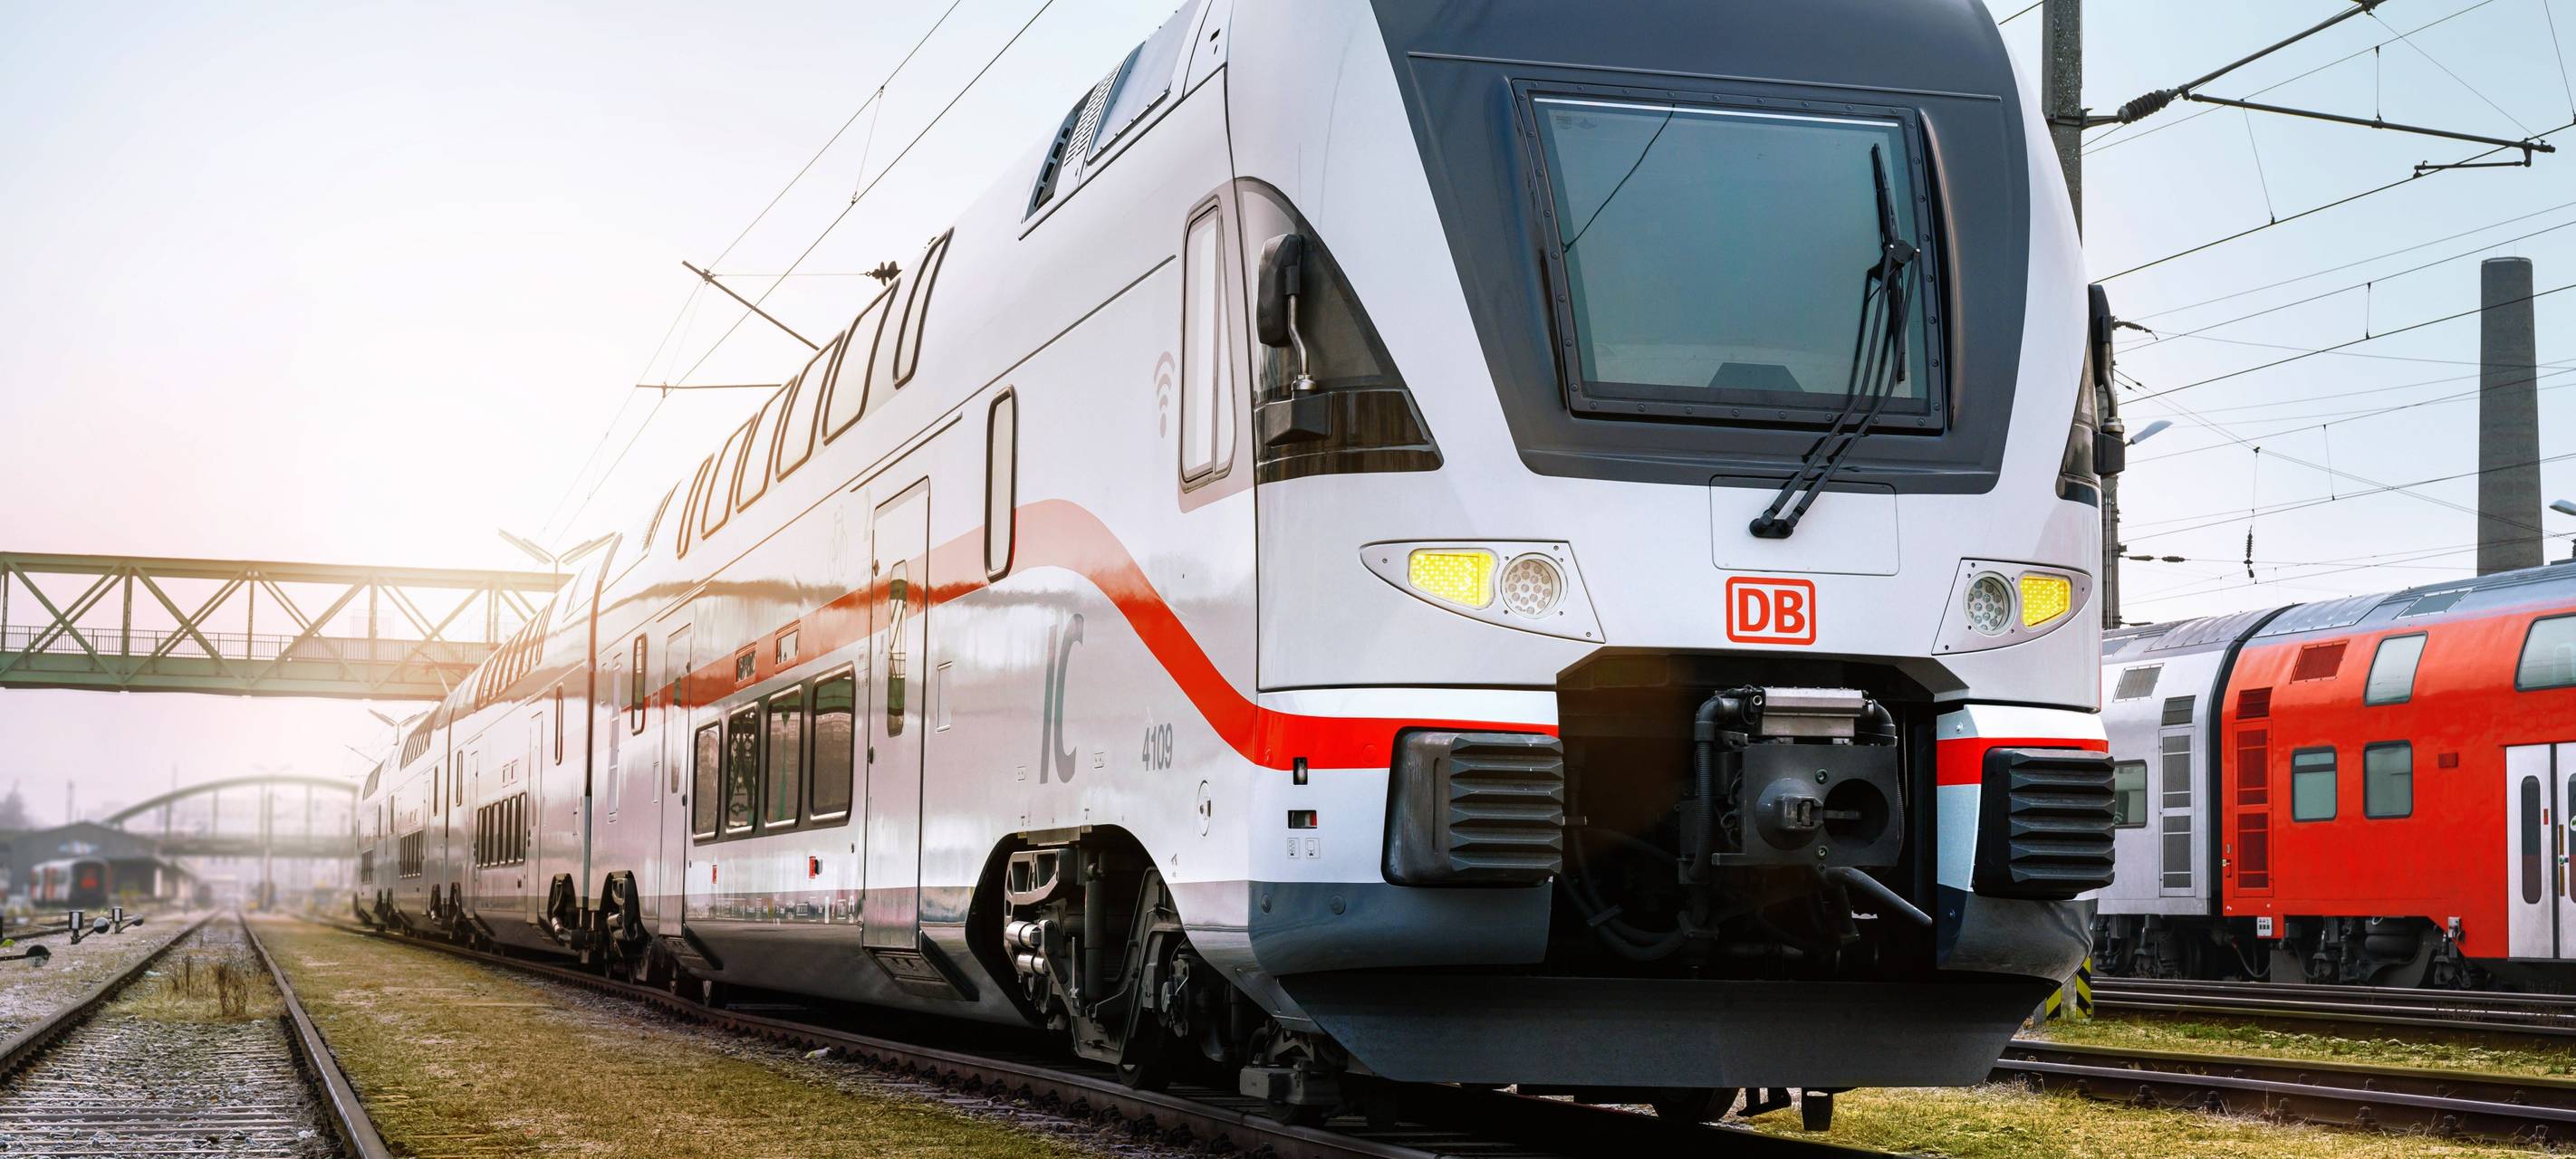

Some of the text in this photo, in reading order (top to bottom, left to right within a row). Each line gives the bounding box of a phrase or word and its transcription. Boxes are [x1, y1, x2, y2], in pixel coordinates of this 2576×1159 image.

[1735, 586, 1807, 636] DB
[1039, 613, 1084, 784] IC
[1142, 722, 1173, 771] 4109
